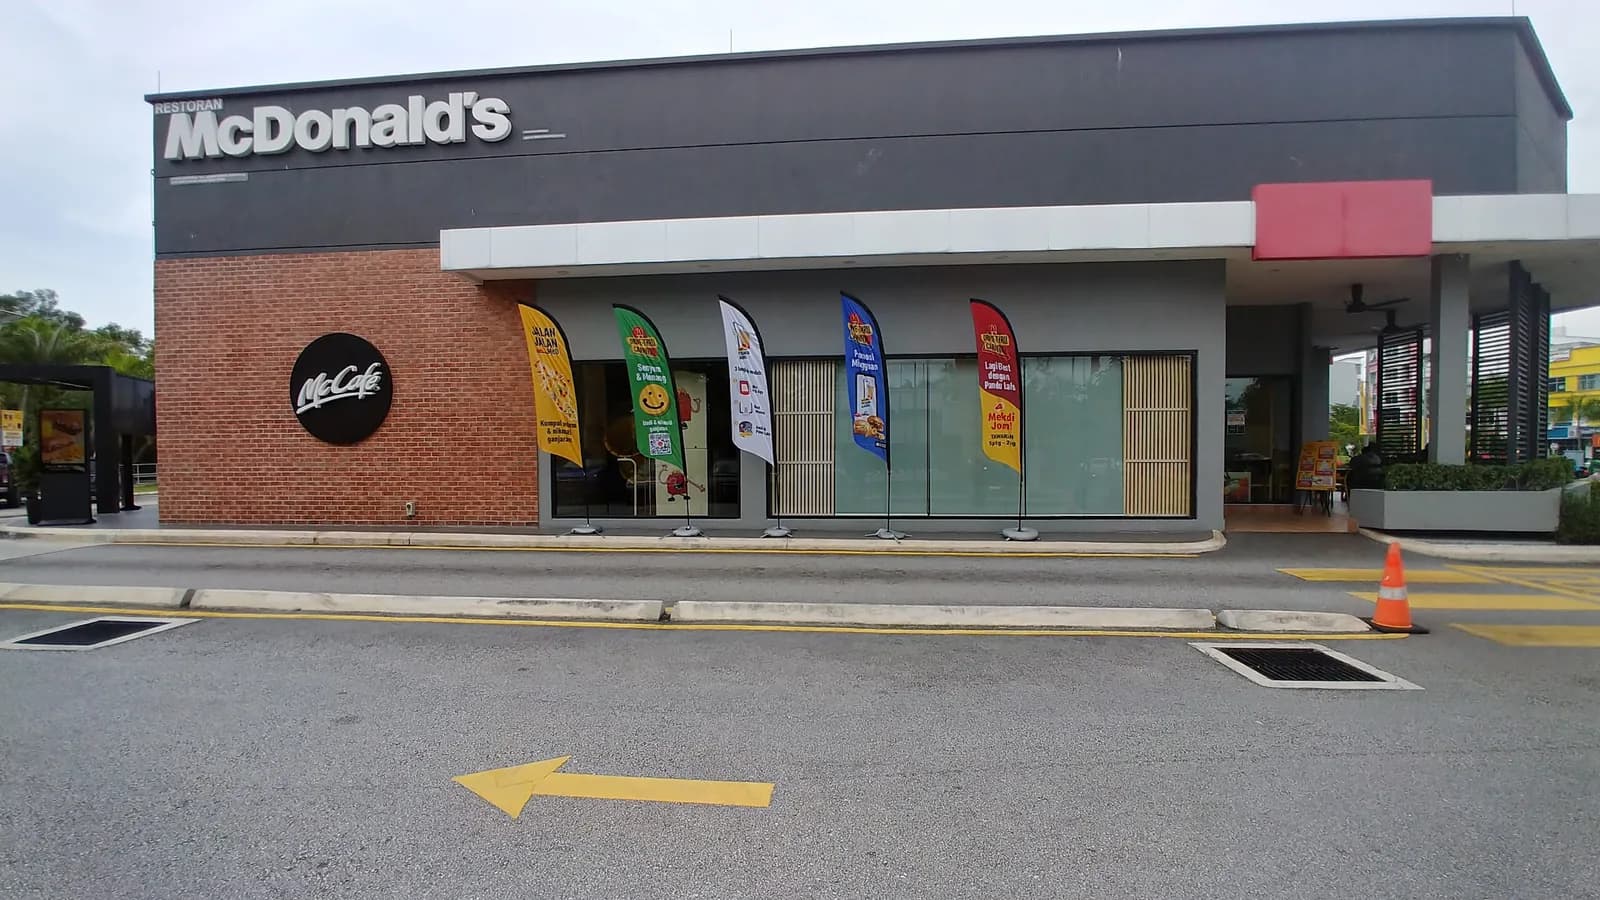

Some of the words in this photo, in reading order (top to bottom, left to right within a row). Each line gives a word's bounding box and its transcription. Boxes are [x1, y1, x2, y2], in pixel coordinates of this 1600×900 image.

[154, 98, 224, 114] RESTORAN
[163, 91, 514, 162] McDonald's
[532, 326, 556, 338] JALAN
[535, 336, 559, 348] JALAN
[984, 361, 998, 372] Lagi
[297, 362, 383, 409] McCafé
[988, 412, 1015, 422] Mekdi
